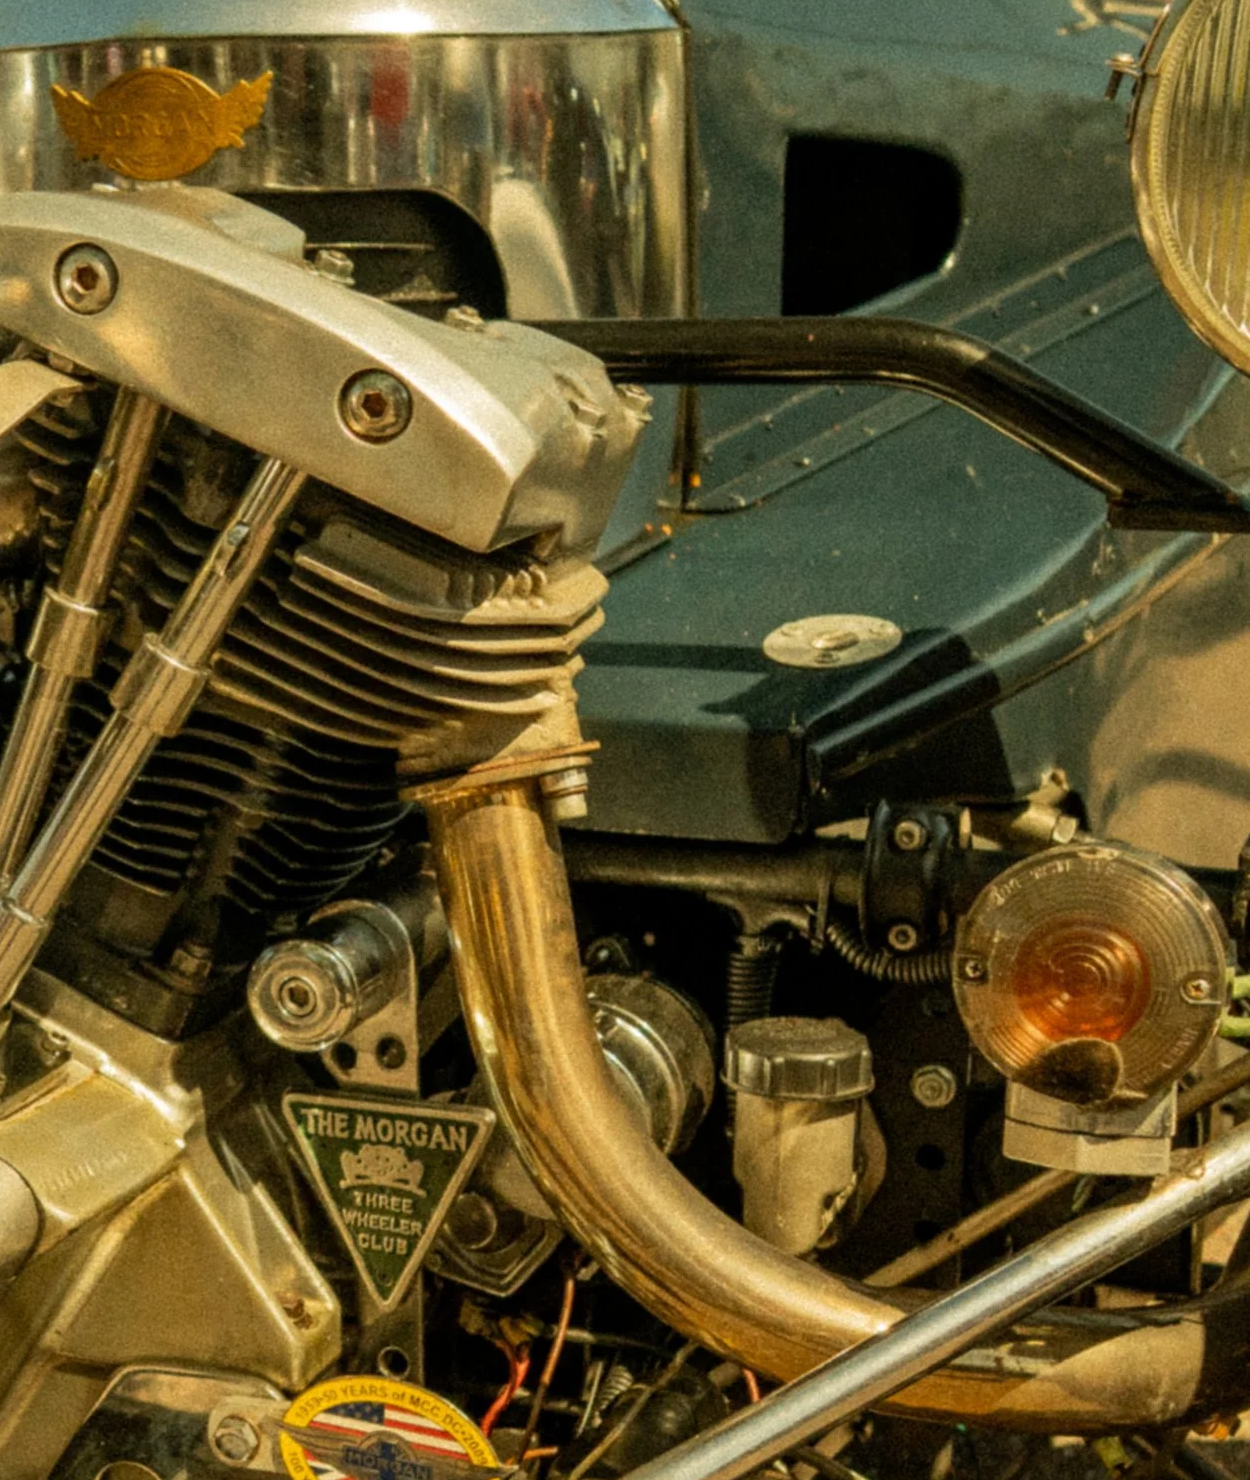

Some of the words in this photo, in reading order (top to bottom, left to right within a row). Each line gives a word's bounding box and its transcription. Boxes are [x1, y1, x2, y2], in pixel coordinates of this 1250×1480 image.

[300, 1107, 350, 1139] THE
[354, 1115, 469, 1153] MORGAN
[353, 1190, 414, 1215] THREE
[342, 1208, 423, 1237] WHEELER
[358, 1233, 408, 1256] CLUB
[341, 1384, 388, 1399] YEARS
[392, 1391, 406, 1402] of
[410, 1394, 440, 1418] MCC
[289, 1451, 304, 1474] 100
